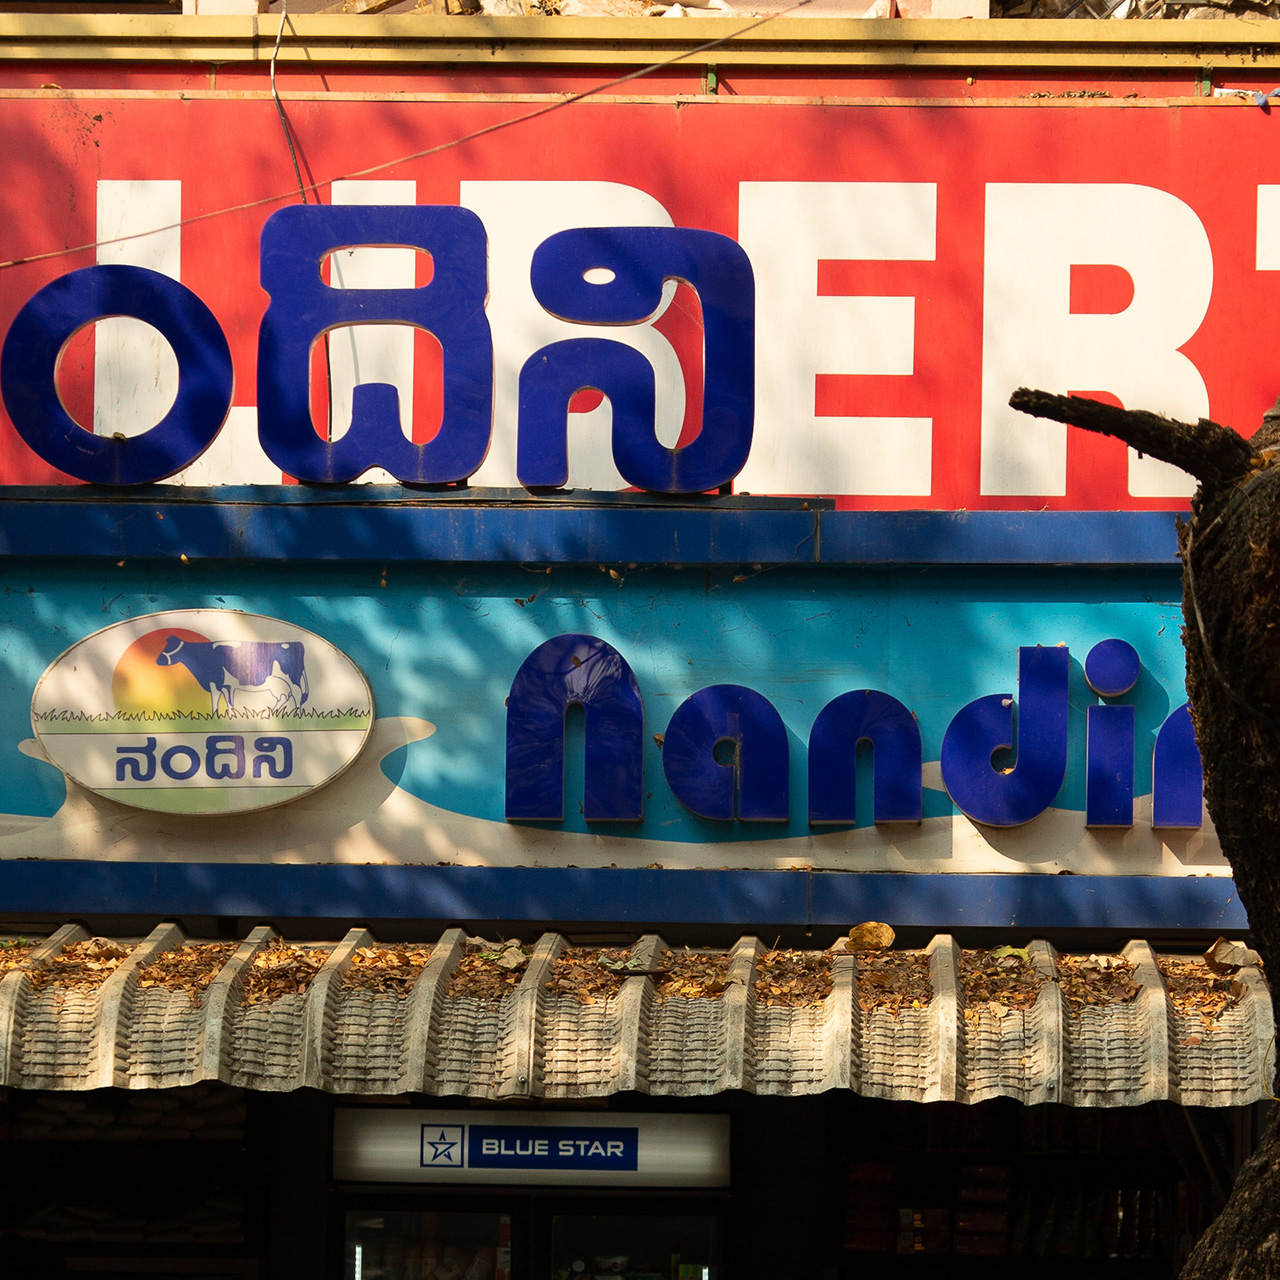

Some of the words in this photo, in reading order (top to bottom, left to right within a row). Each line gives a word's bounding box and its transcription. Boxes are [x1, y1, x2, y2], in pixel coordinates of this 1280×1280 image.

[503, 632, 1205, 830] Nandi
[115, 735, 294, 782] ನಂದಿನಿ
[482, 1138, 550, 1156] BLUE
[558, 1139, 625, 1158] STAR
